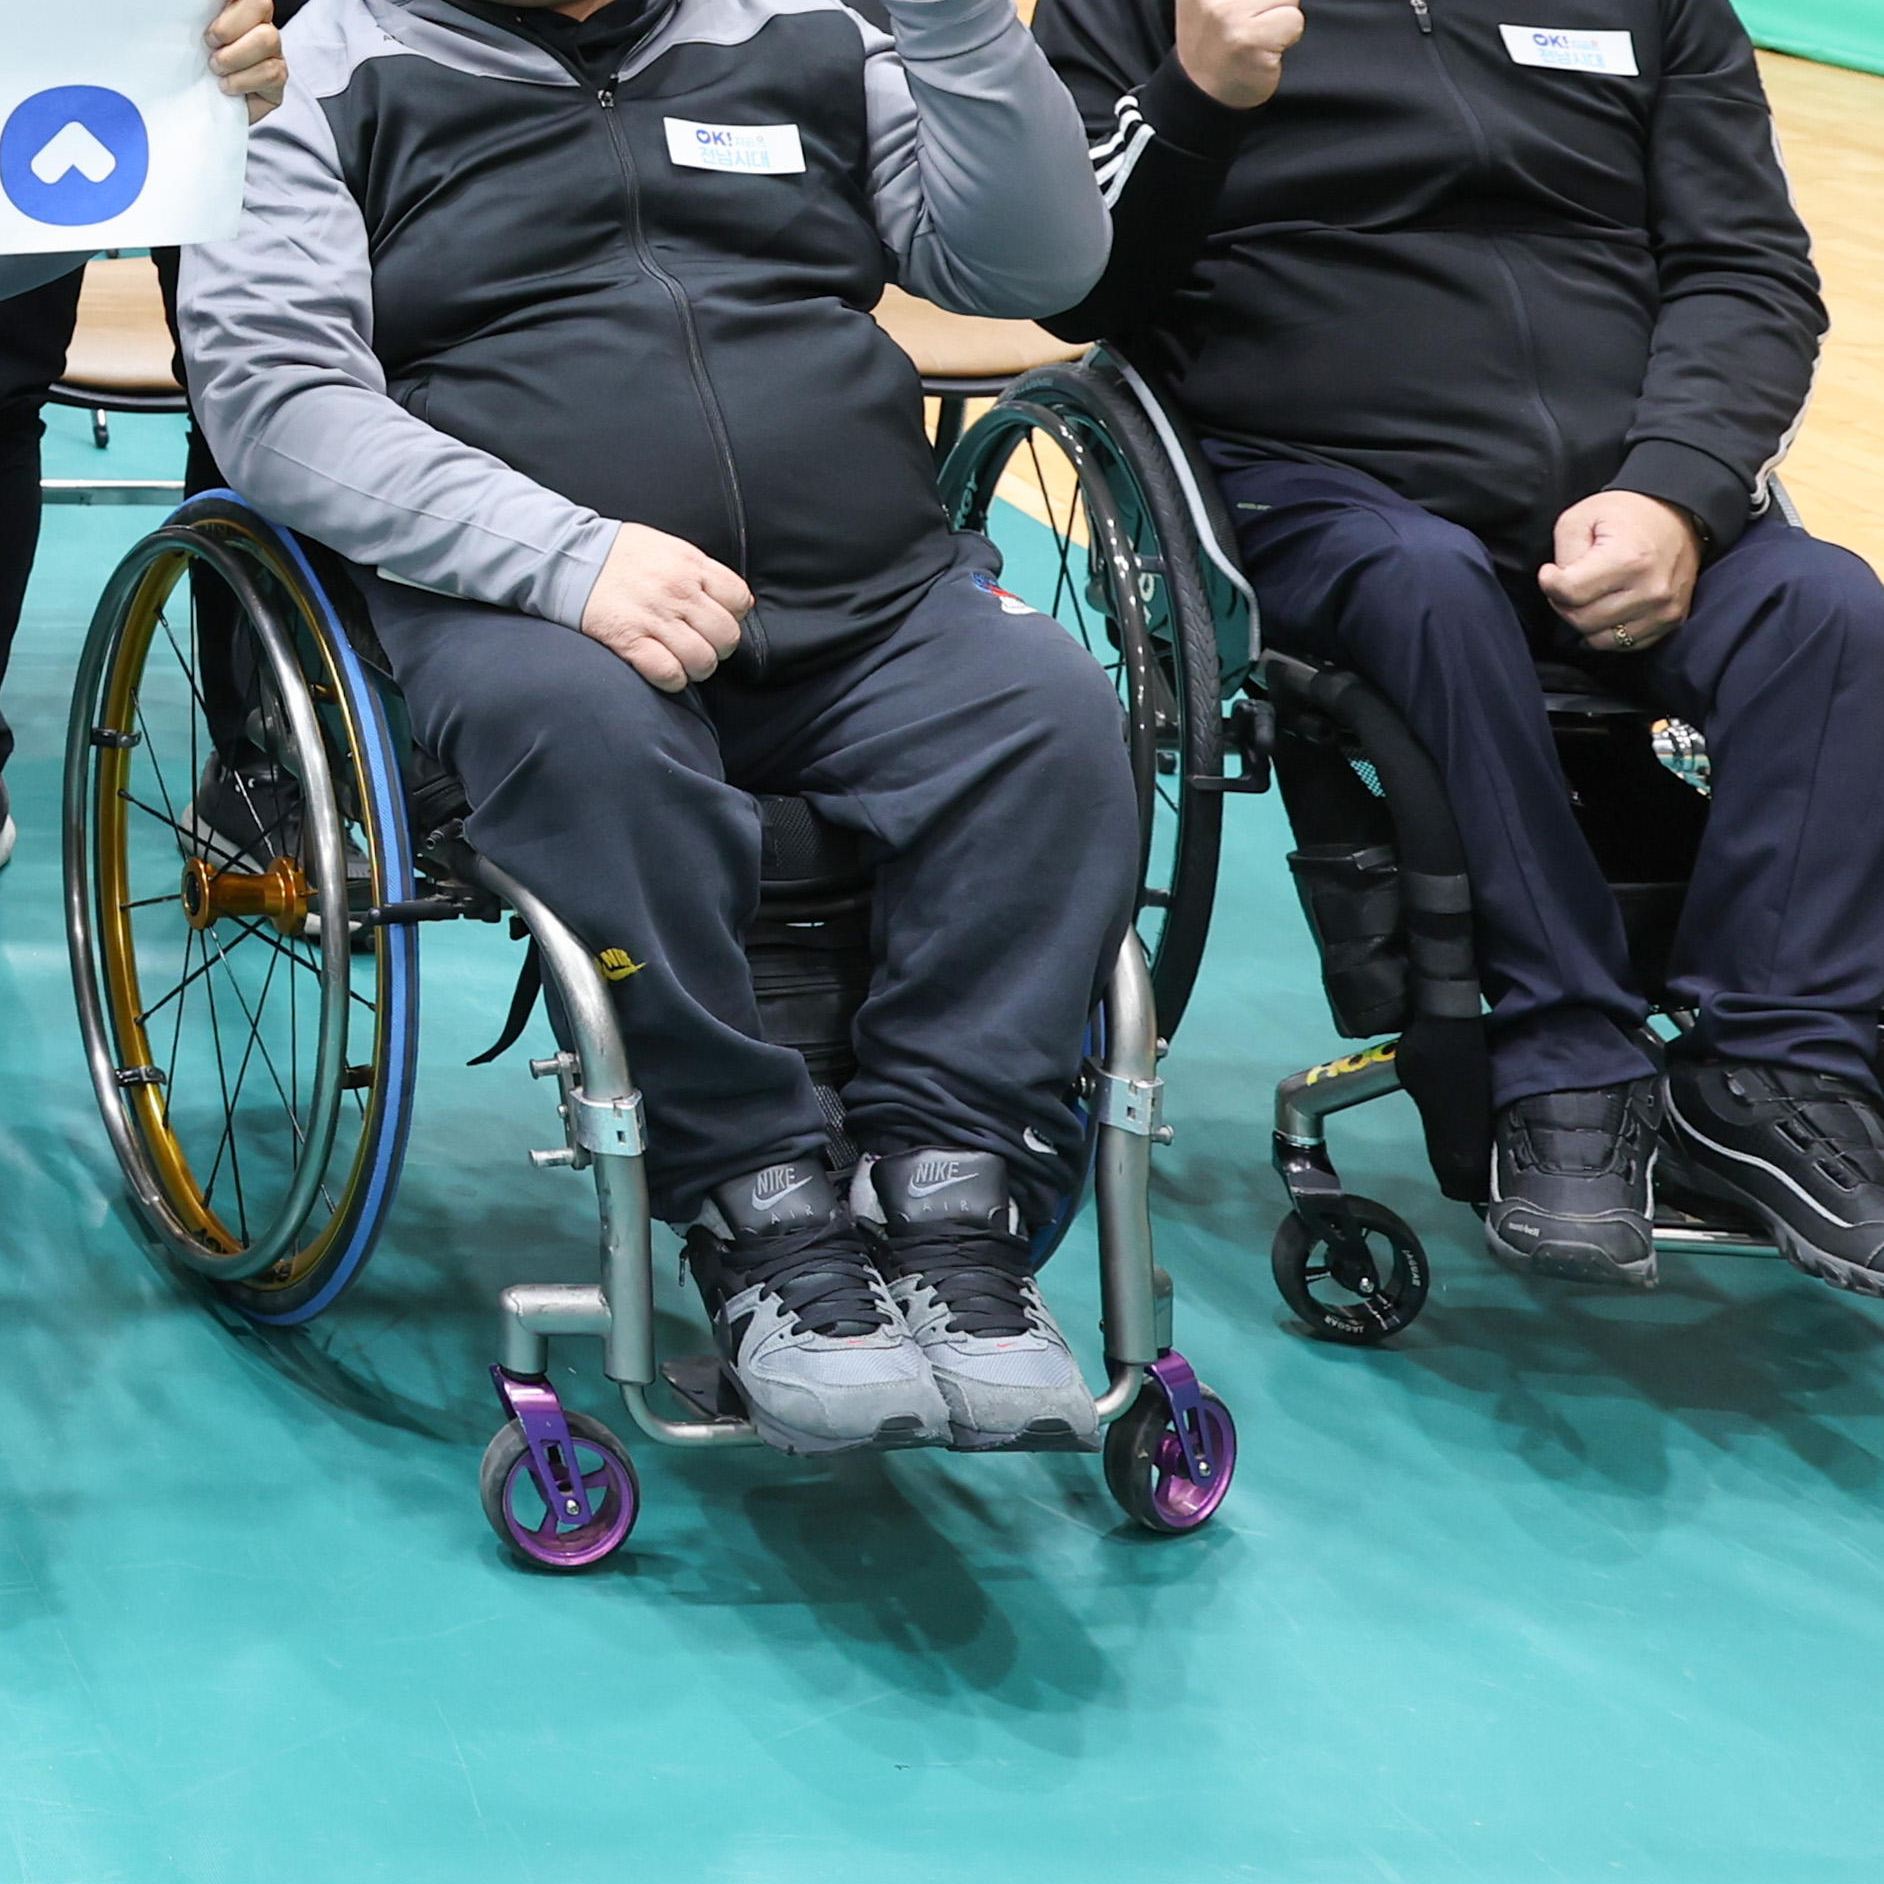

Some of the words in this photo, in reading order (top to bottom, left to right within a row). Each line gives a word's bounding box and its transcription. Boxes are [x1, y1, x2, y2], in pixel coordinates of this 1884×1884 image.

[695, 128, 733, 147] OK!
[755, 1166, 797, 1195] NIKE
[915, 1161, 960, 1184] NIKE
[768, 1203, 815, 1225] AIR
[922, 1199, 970, 1213] AIR
